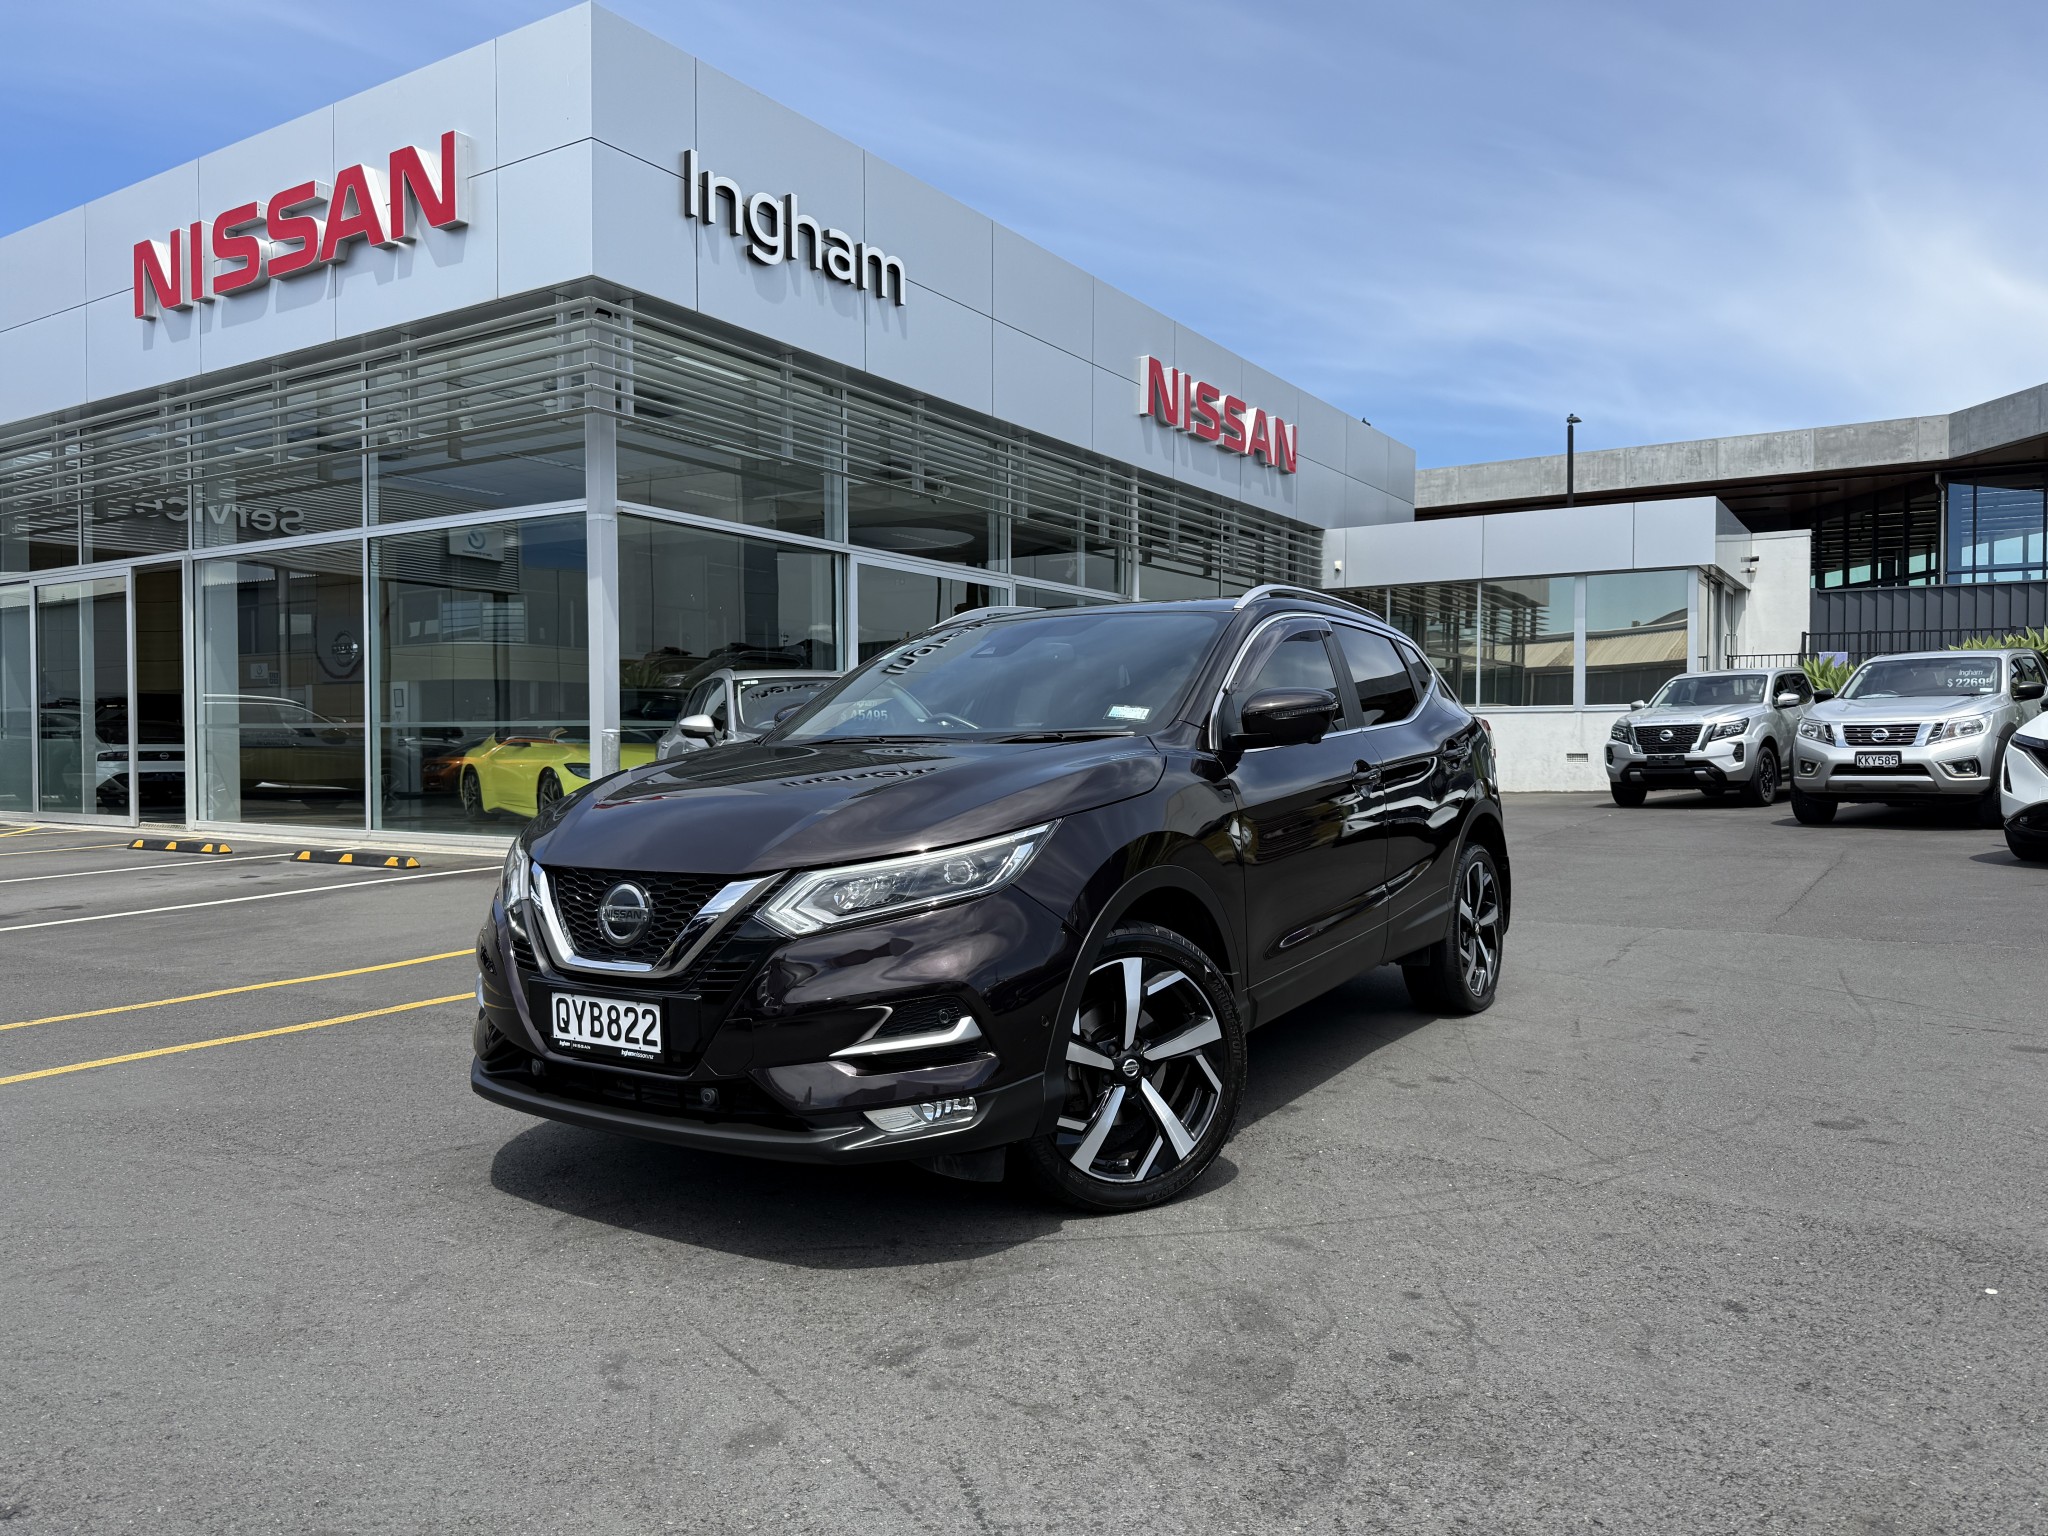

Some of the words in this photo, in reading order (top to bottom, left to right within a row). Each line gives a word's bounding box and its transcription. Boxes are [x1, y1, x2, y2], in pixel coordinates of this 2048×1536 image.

[133, 130, 459, 321] NISSAN
[685, 149, 906, 306] Ingham
[1142, 355, 1297, 473] NISSAN
[1958, 669, 1984, 677] Ingham
[1857, 755, 1898, 766] KKY585
[604, 908, 642, 920] NISSAN
[556, 997, 658, 1047] QYB822
